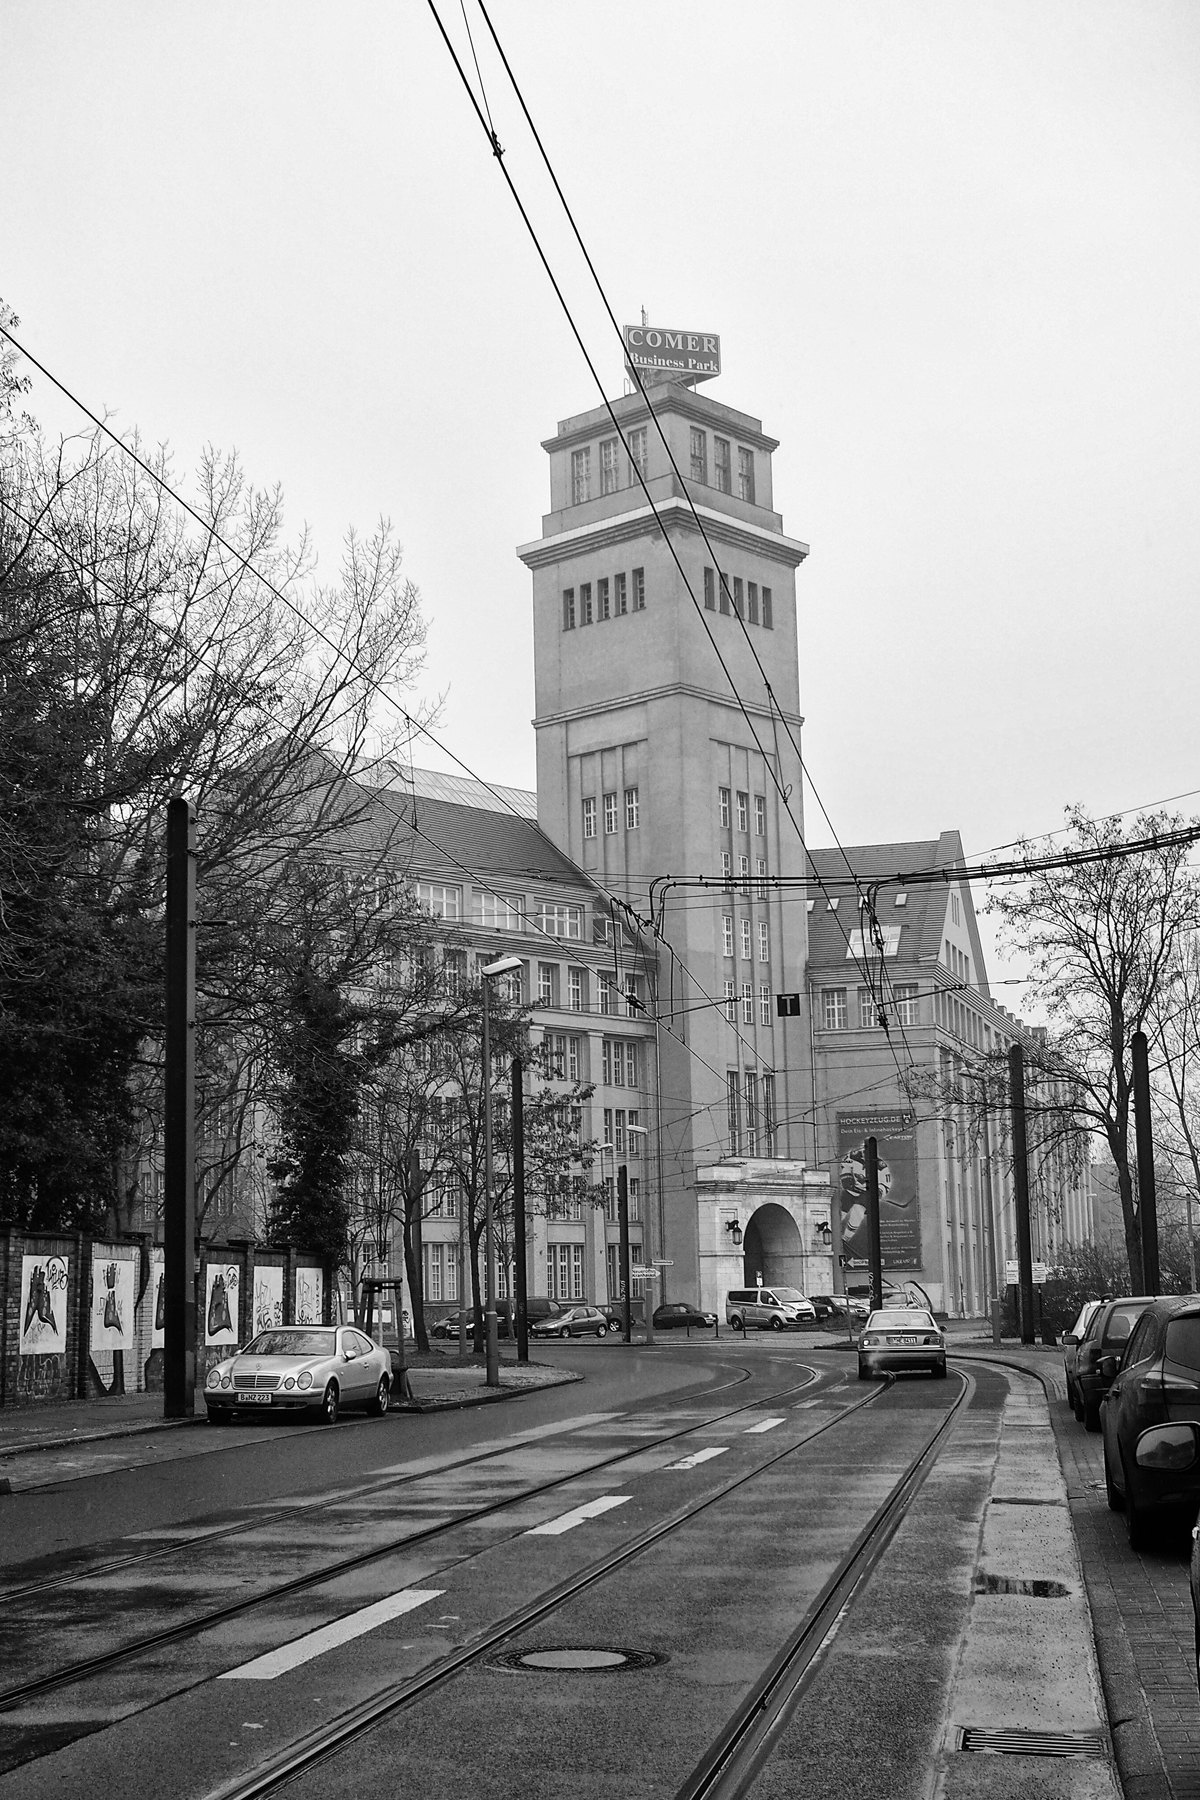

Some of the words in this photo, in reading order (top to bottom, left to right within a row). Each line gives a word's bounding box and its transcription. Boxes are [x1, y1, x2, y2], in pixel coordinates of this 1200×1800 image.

[628, 330, 717, 353] COMER
[629, 352, 684, 368] Business
[687, 358, 718, 371] Park
[840, 1116, 901, 1125] HOCKEYZEUG.DE
